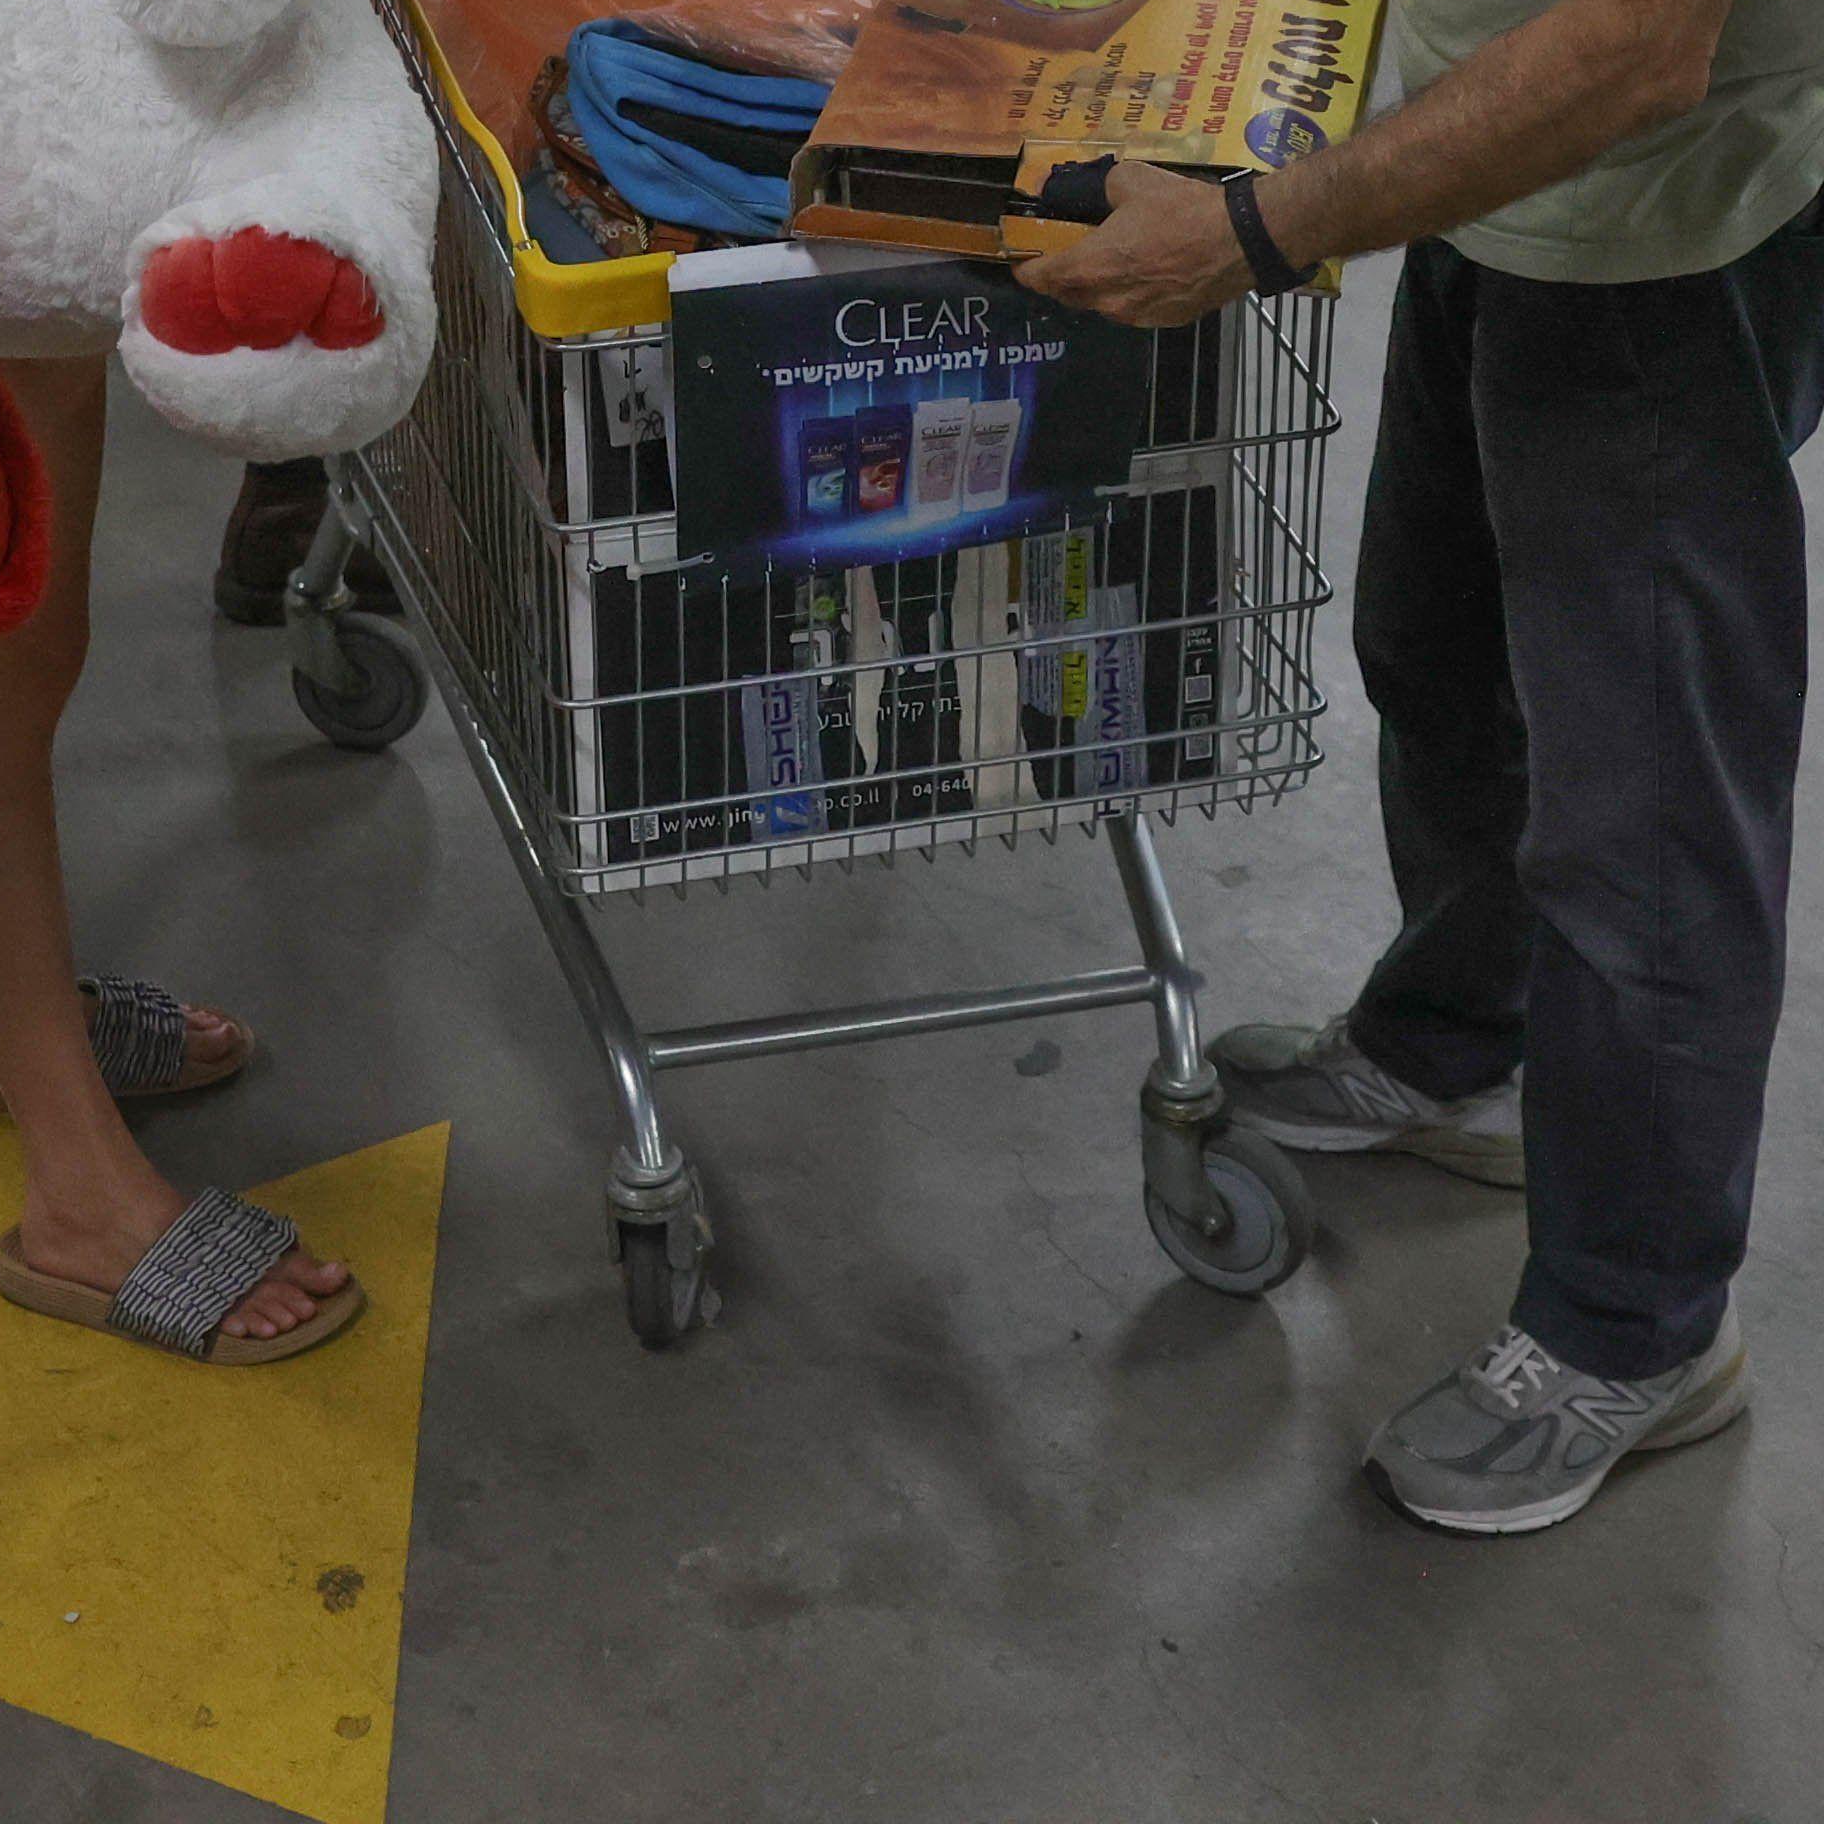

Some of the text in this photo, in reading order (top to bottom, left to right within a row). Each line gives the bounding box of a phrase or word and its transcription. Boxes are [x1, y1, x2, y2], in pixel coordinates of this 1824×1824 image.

[1261, 13, 1350, 115] פלטת
[1039, 81, 1078, 119] קל לניקוי
[835, 296, 991, 347] CLEAR
[893, 346, 988, 375] למניעת
[998, 341, 1065, 366] שמפו
[921, 423, 961, 437] CLEAR
